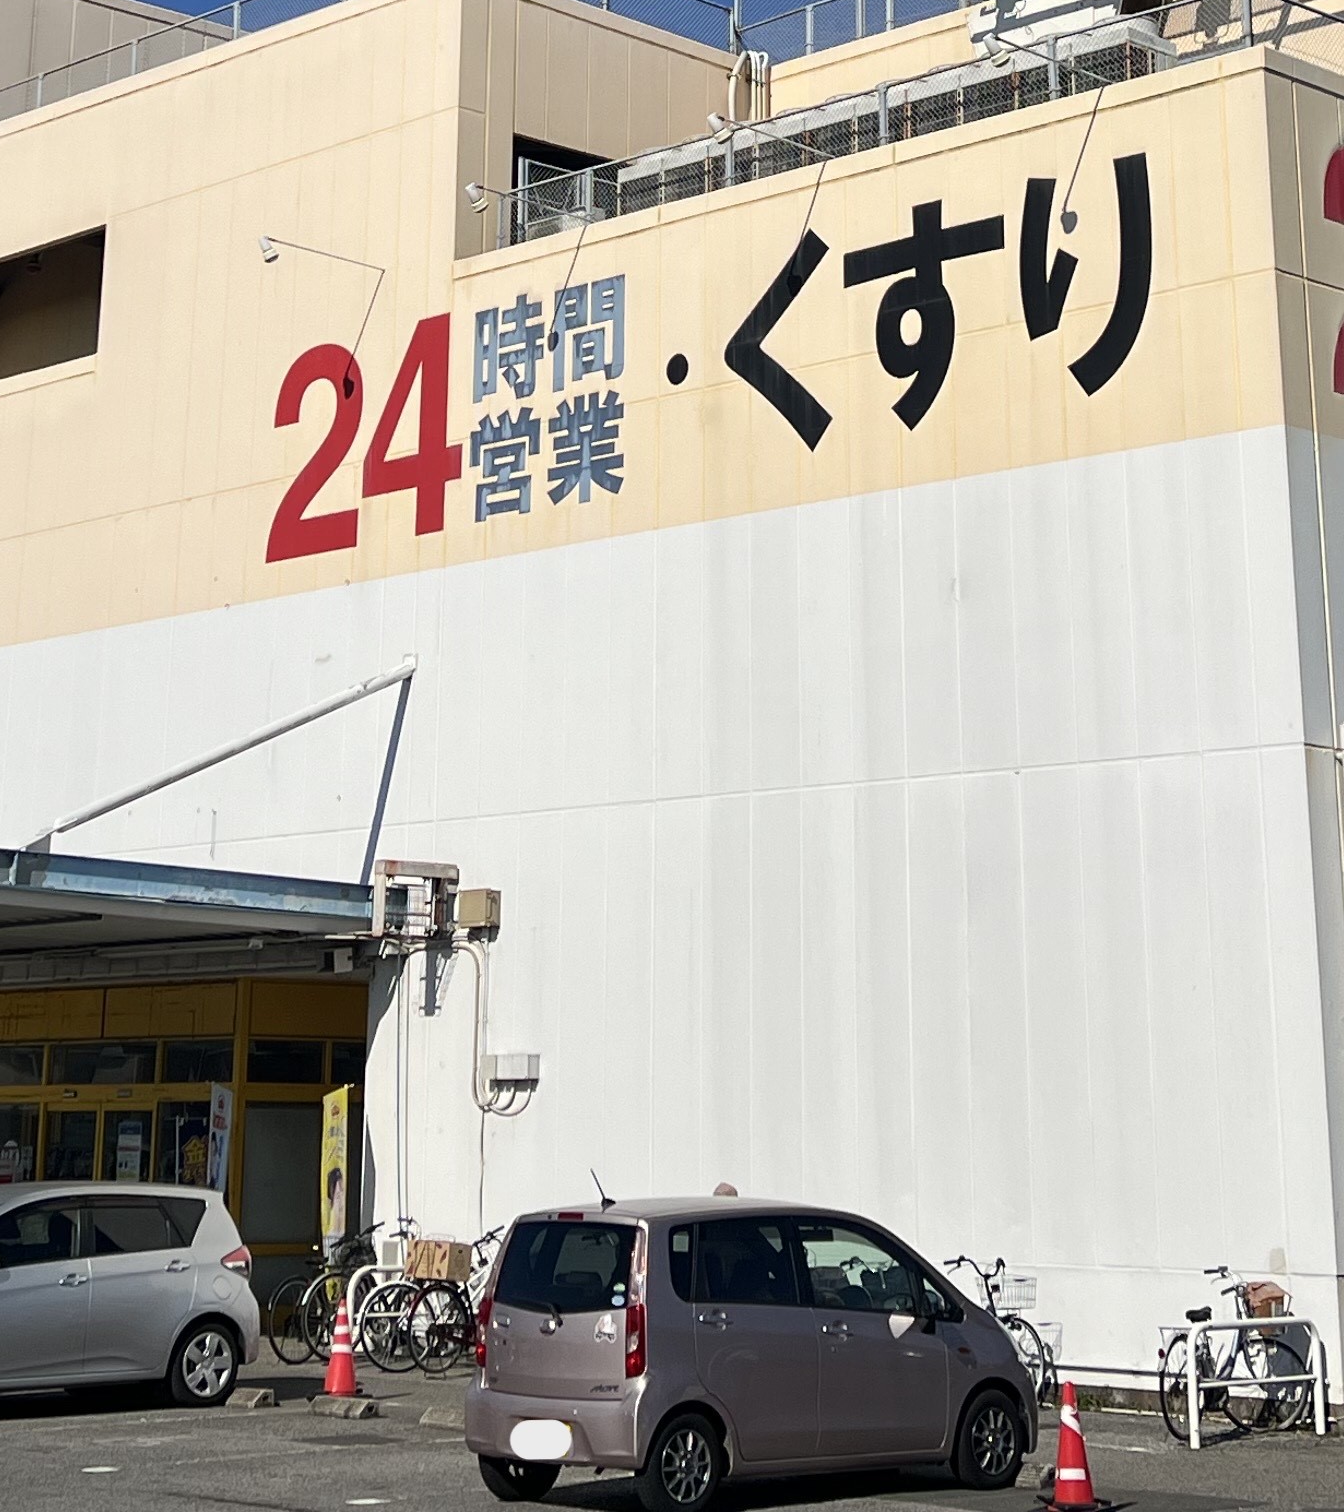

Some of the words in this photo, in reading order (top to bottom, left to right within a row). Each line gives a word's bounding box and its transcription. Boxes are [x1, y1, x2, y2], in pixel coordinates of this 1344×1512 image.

[471, 274, 626, 404] 時間
[265, 312, 463, 563] 24
[469, 389, 626, 523] 営業
